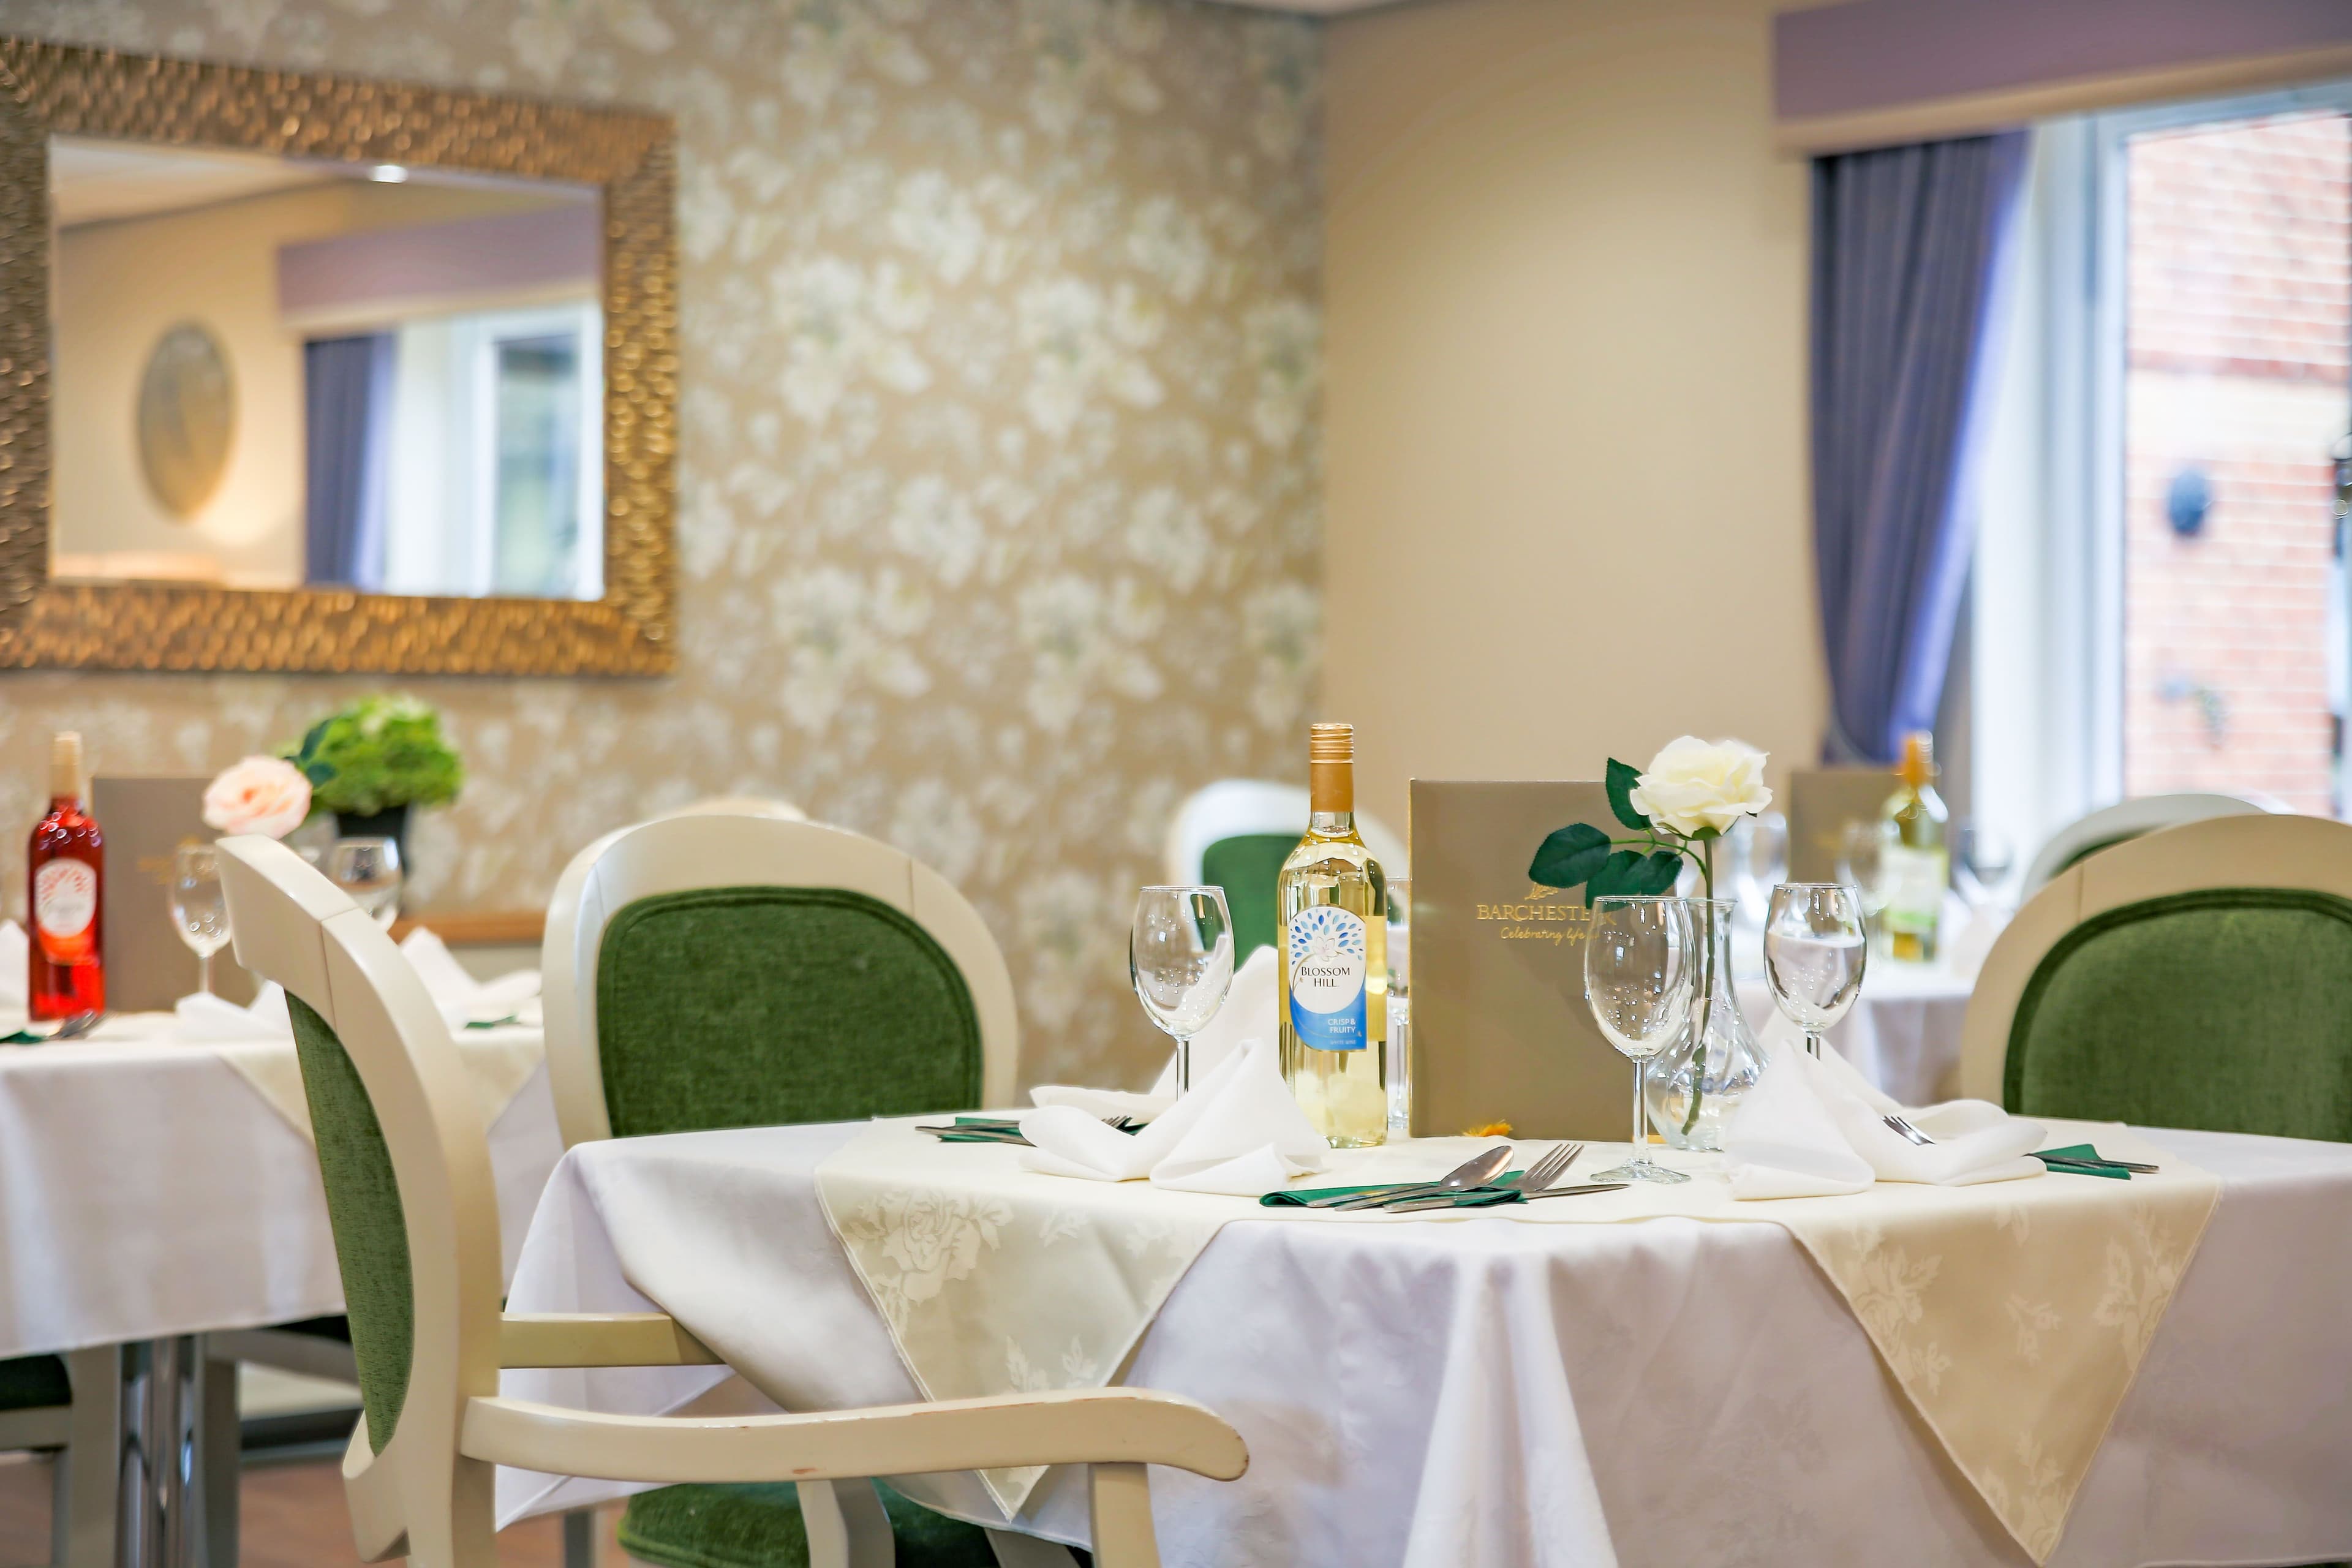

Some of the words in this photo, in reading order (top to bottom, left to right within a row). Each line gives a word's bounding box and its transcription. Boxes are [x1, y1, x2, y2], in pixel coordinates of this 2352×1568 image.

[1501, 926, 1562, 946] Celebrating
[1301, 967, 1350, 976] BLOSSOM
[1314, 978, 1336, 987] HILL
